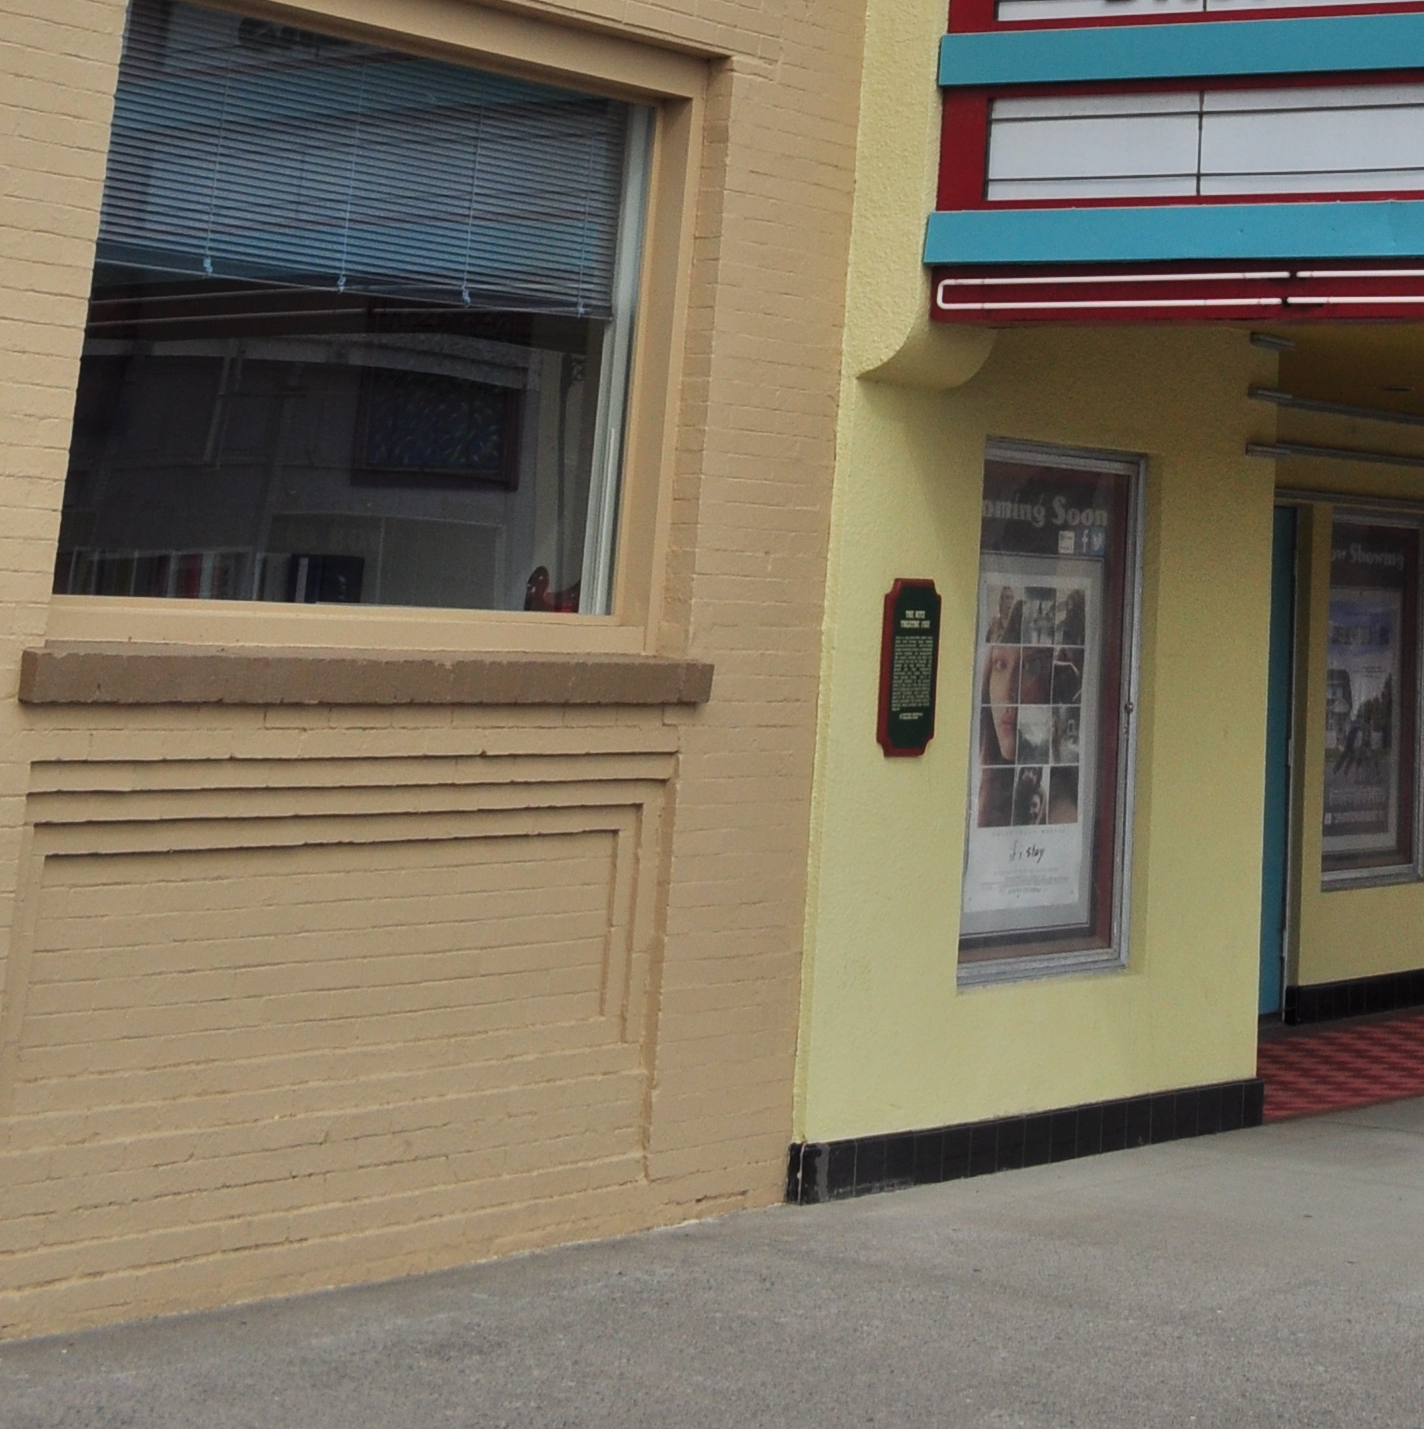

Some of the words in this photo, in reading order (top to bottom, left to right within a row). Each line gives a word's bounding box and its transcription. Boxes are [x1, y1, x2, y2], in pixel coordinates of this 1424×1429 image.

[982, 492, 1046, 528] oming
[1051, 495, 1109, 526] Soon
[1026, 844, 1045, 864] stay
